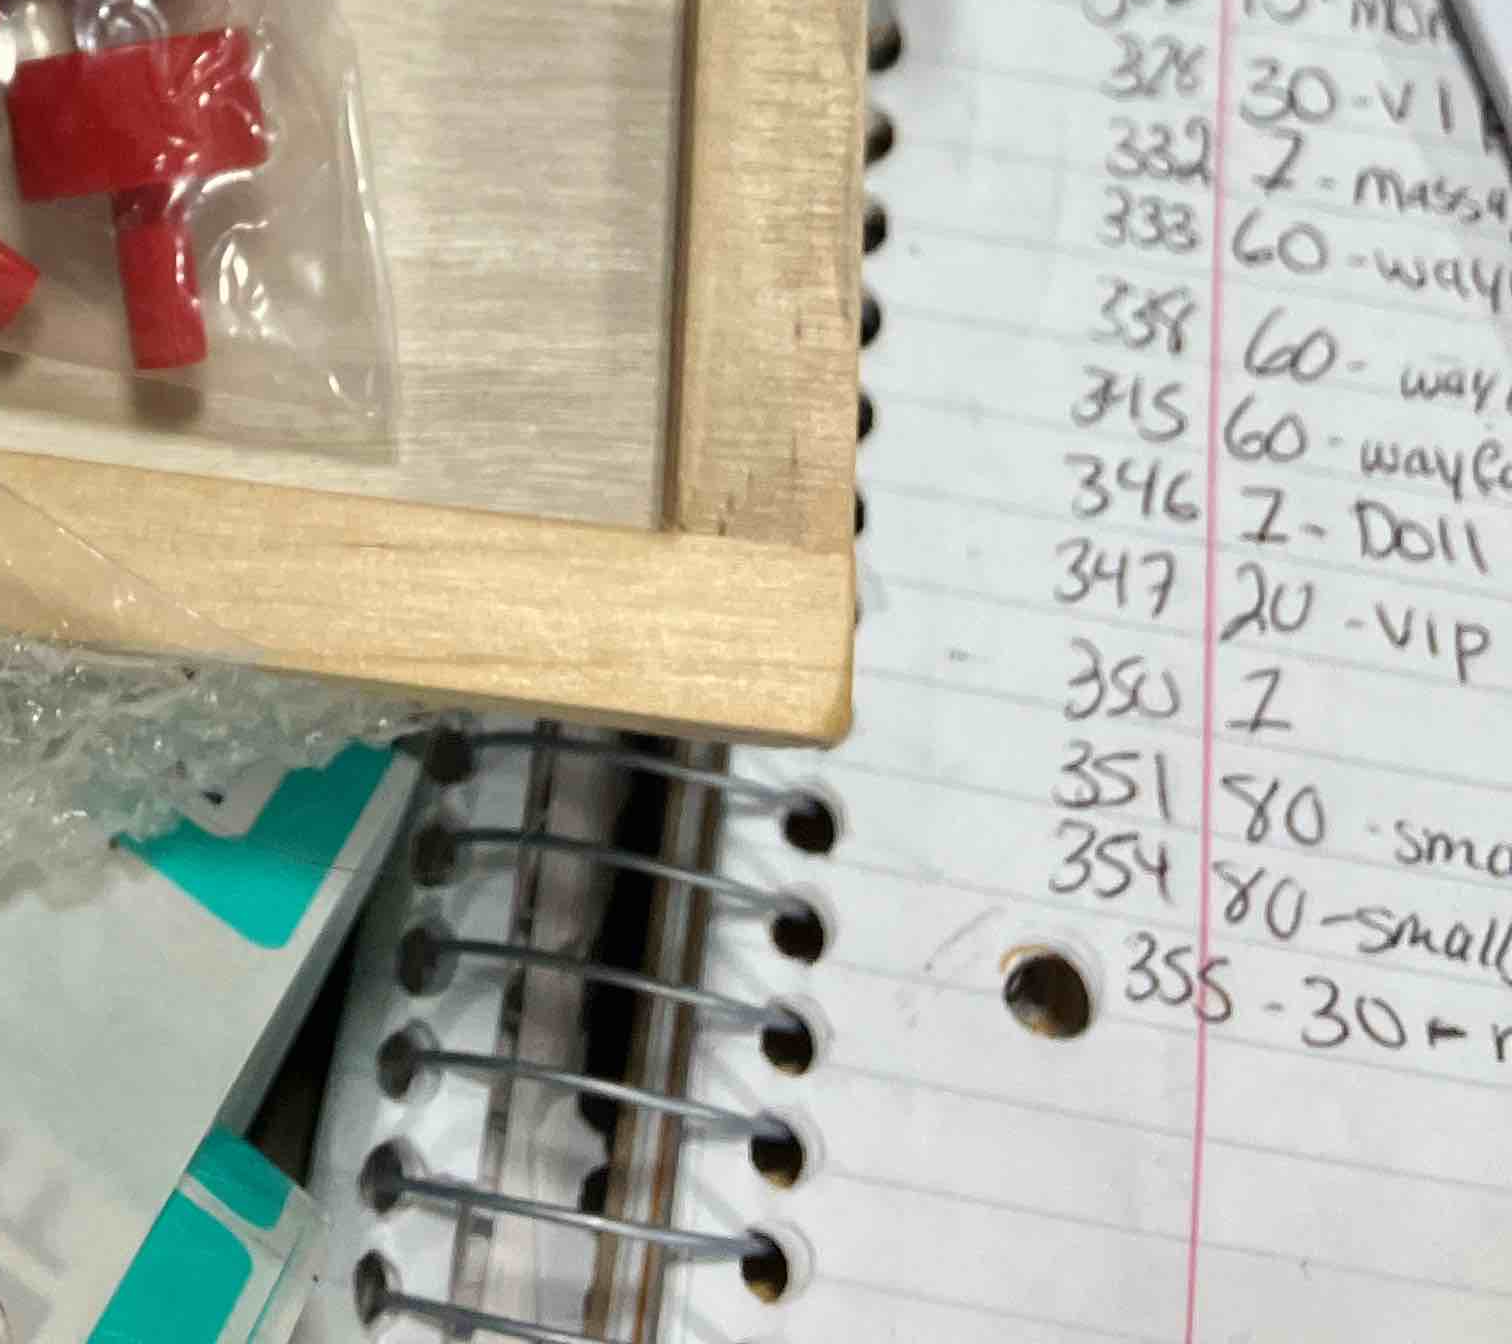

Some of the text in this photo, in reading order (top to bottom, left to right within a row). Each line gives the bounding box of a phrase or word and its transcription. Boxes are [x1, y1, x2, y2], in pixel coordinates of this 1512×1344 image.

[1239, 56, 1338, 127] 30
[1232, 206, 1330, 275] 60
[1373, 245, 1512, 315] way
[1243, 305, 1339, 384] 60
[1399, 366, 1512, 416] way
[1222, 392, 1310, 462] 60
[1063, 452, 1202, 523] 346
[1053, 536, 1177, 619] 347
[1218, 560, 1317, 644] 20
[1062, 636, 1182, 721] 350
[1051, 739, 1172, 822] 351
[1220, 772, 1326, 847] 80
[1047, 817, 1176, 907] 354
[1211, 859, 1308, 941] 80
[1123, 929, 1234, 1024] 355
[1300, 974, 1408, 1050] 30
